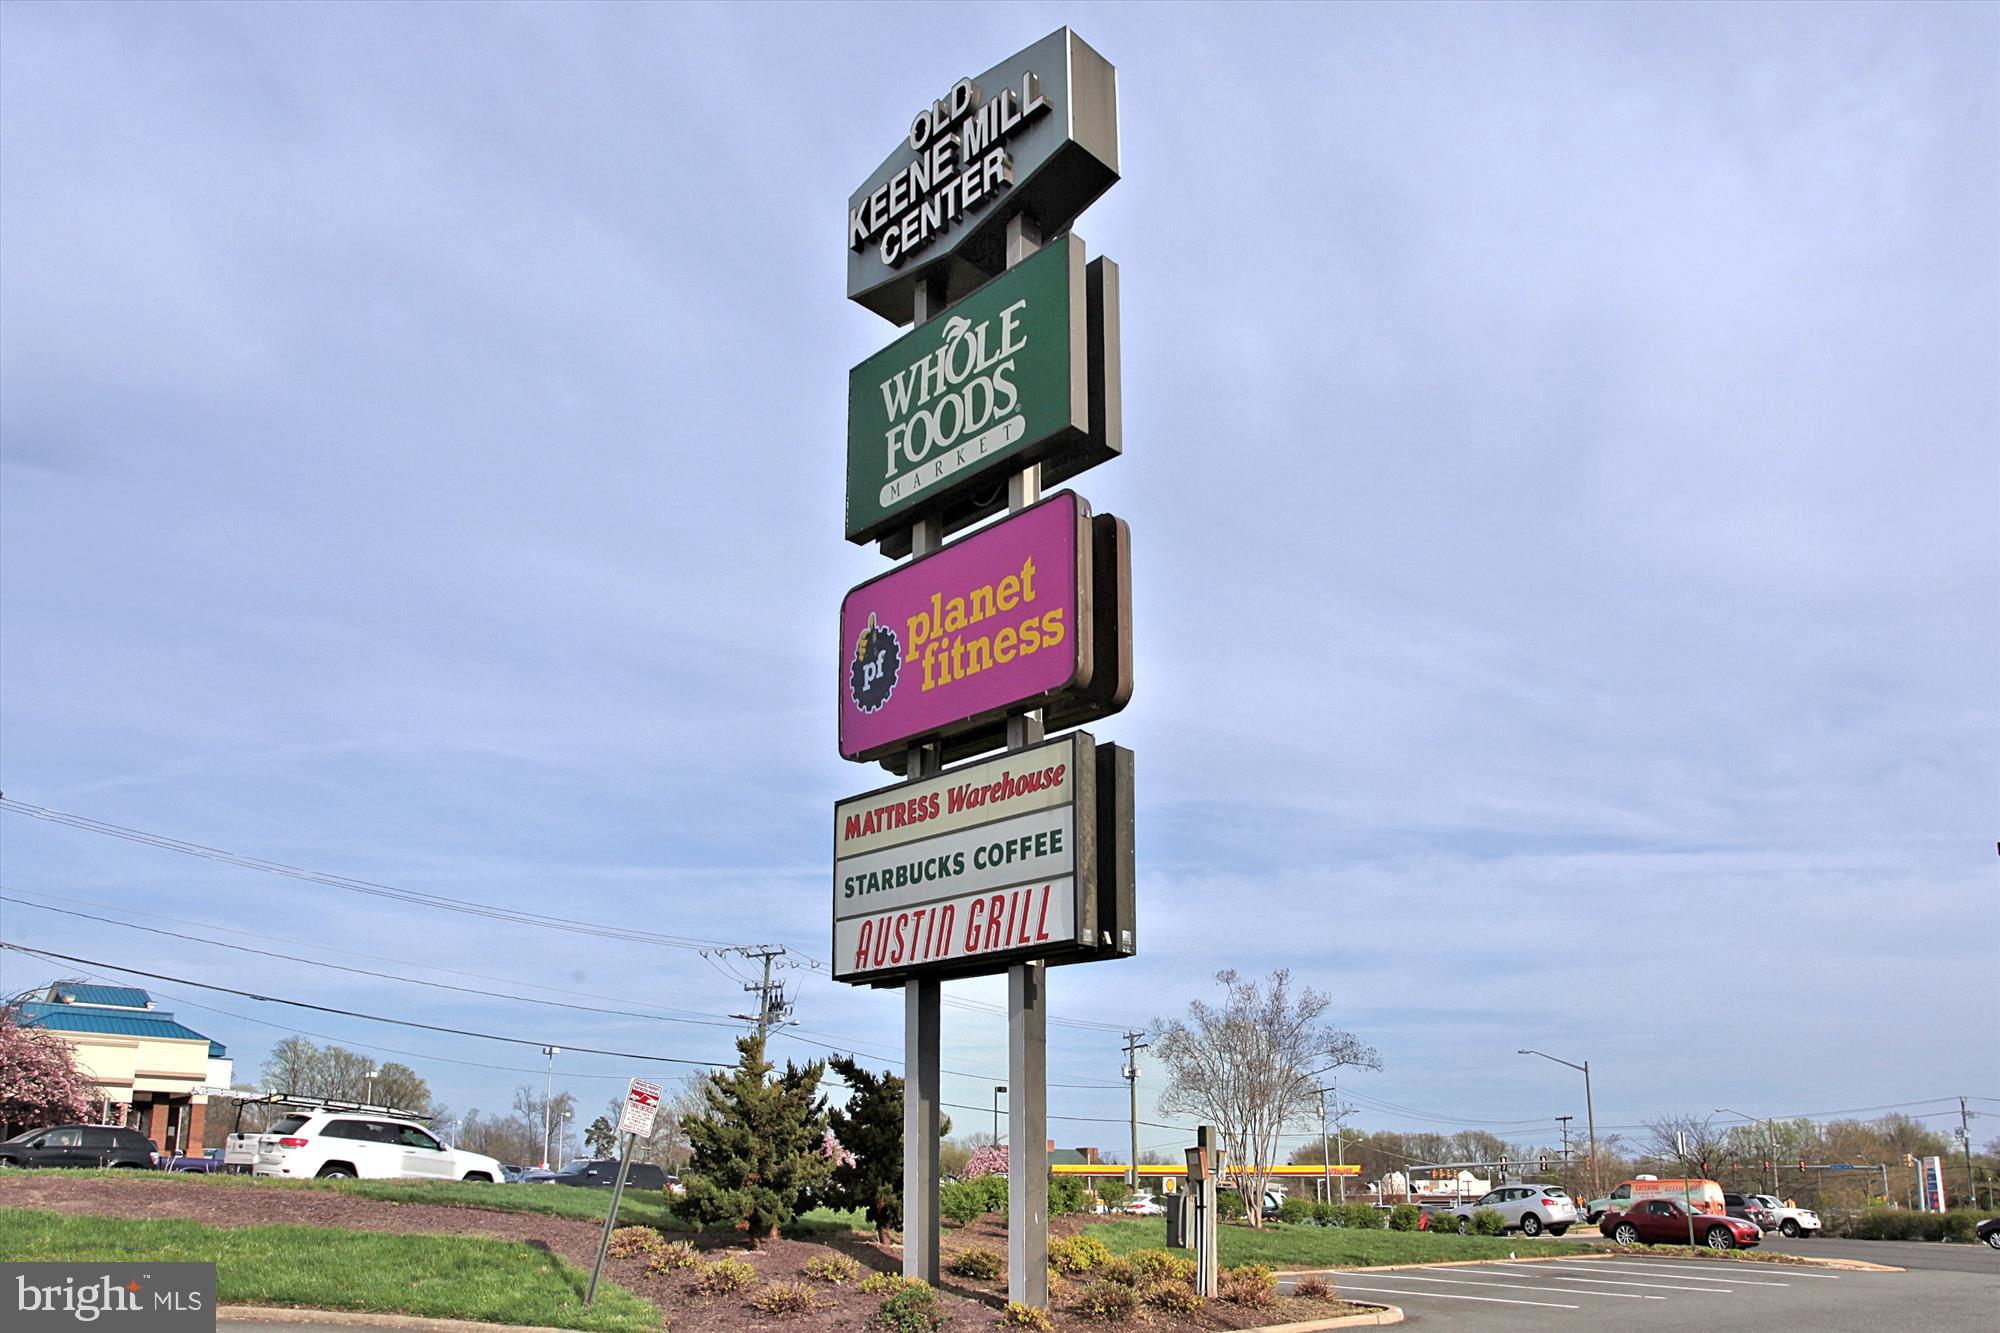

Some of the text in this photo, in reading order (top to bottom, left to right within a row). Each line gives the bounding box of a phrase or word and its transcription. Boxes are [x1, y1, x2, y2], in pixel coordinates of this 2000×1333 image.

[909, 77, 977, 150] OLD
[850, 71, 1048, 250] KEENE MILL
[880, 147, 1010, 265] CENTER
[880, 299, 1028, 422] WHOLE
[885, 359, 1018, 479] FOODS
[890, 423, 1013, 501] MARKET
[905, 555, 1036, 663] planet
[921, 608, 1065, 692] fitness
[862, 650, 886, 691] pf
[844, 763, 1066, 841] MATTRESS Warehouse
[844, 828, 1063, 898] STARBUCKS COFFEE
[855, 884, 1051, 971] AUSTIN GRILL
